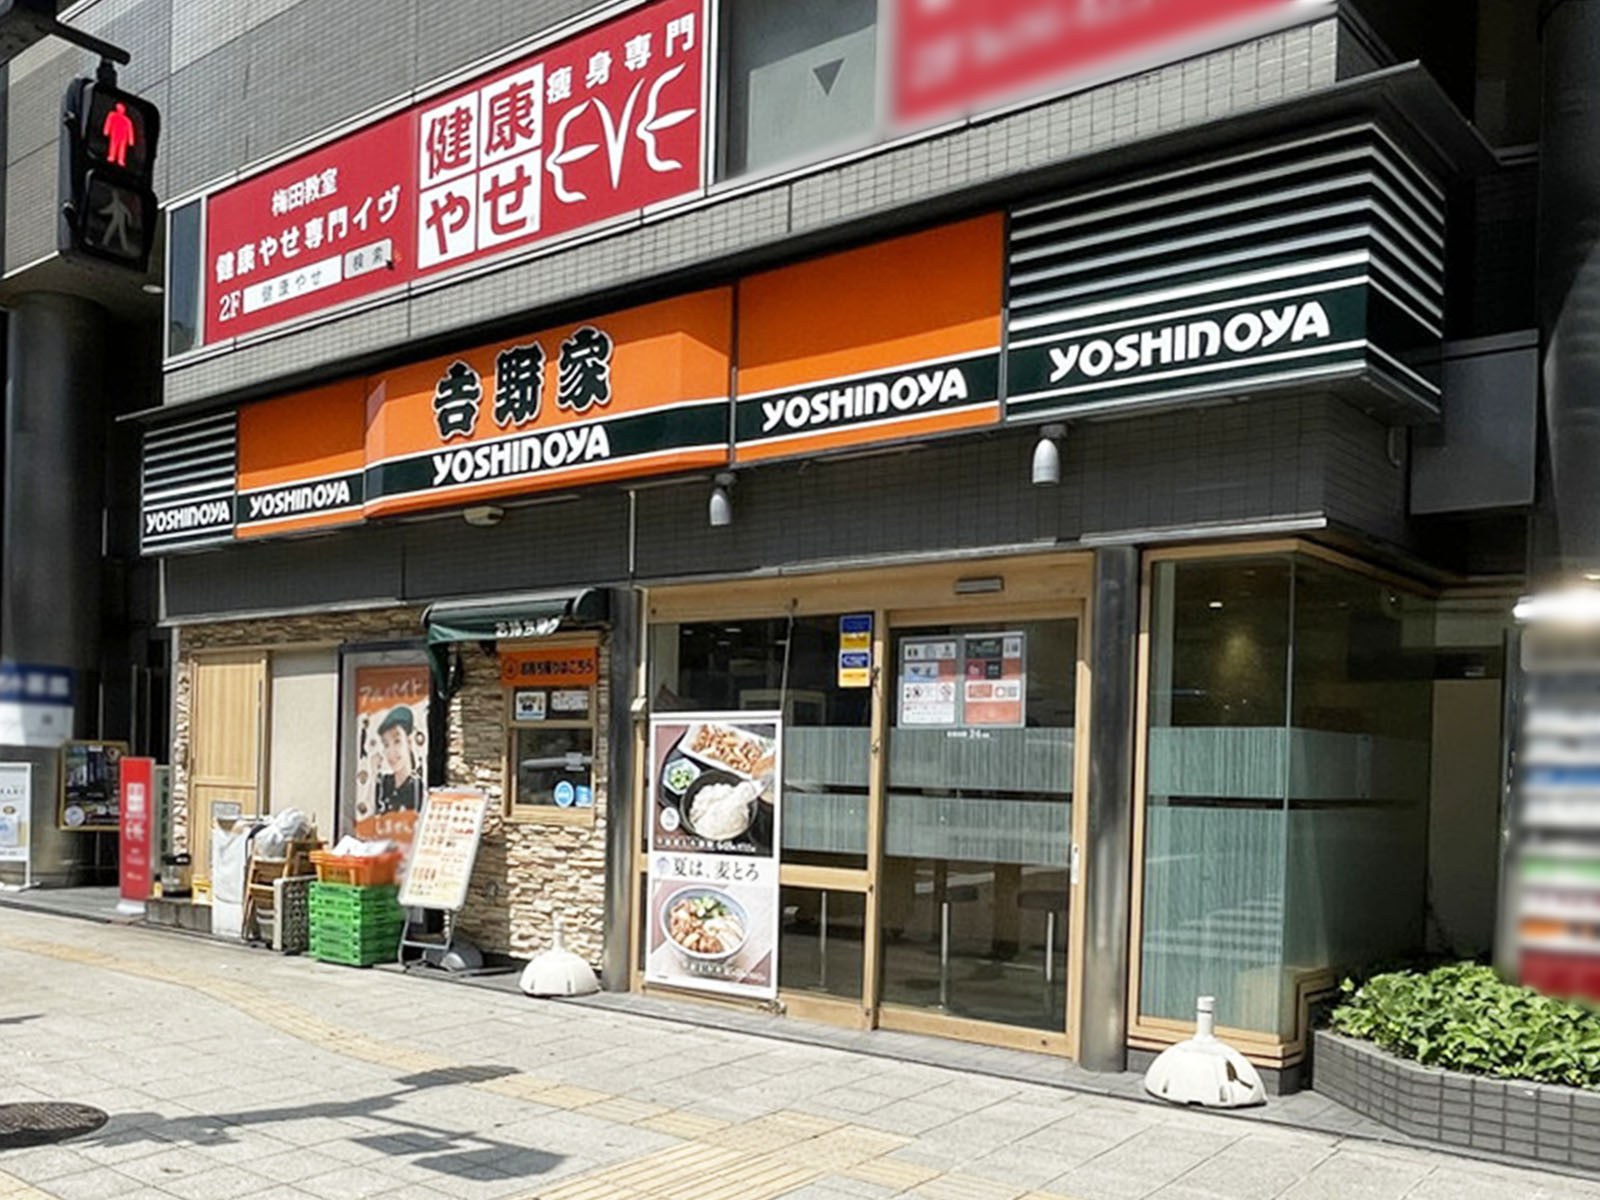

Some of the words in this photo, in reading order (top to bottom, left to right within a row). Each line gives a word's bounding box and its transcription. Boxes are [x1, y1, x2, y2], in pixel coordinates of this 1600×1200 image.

[546, 13, 695, 104] 痩身専門
[426, 79, 535, 180] 健康
[545, 63, 697, 204] EVE
[271, 167, 338, 217] 梅田教室
[425, 164, 532, 256] やせ
[215, 185, 401, 284] 健康やせ専門イヴ
[218, 290, 243, 322] 2F
[1047, 300, 1331, 383] YOSHINOYA
[432, 326, 614, 441] 吉野家
[762, 367, 968, 432] YOSHINOYA
[432, 424, 611, 486] YOSHINOYA
[145, 500, 231, 534] YOSHINOYA
[248, 480, 351, 518] YOSHINOYA
